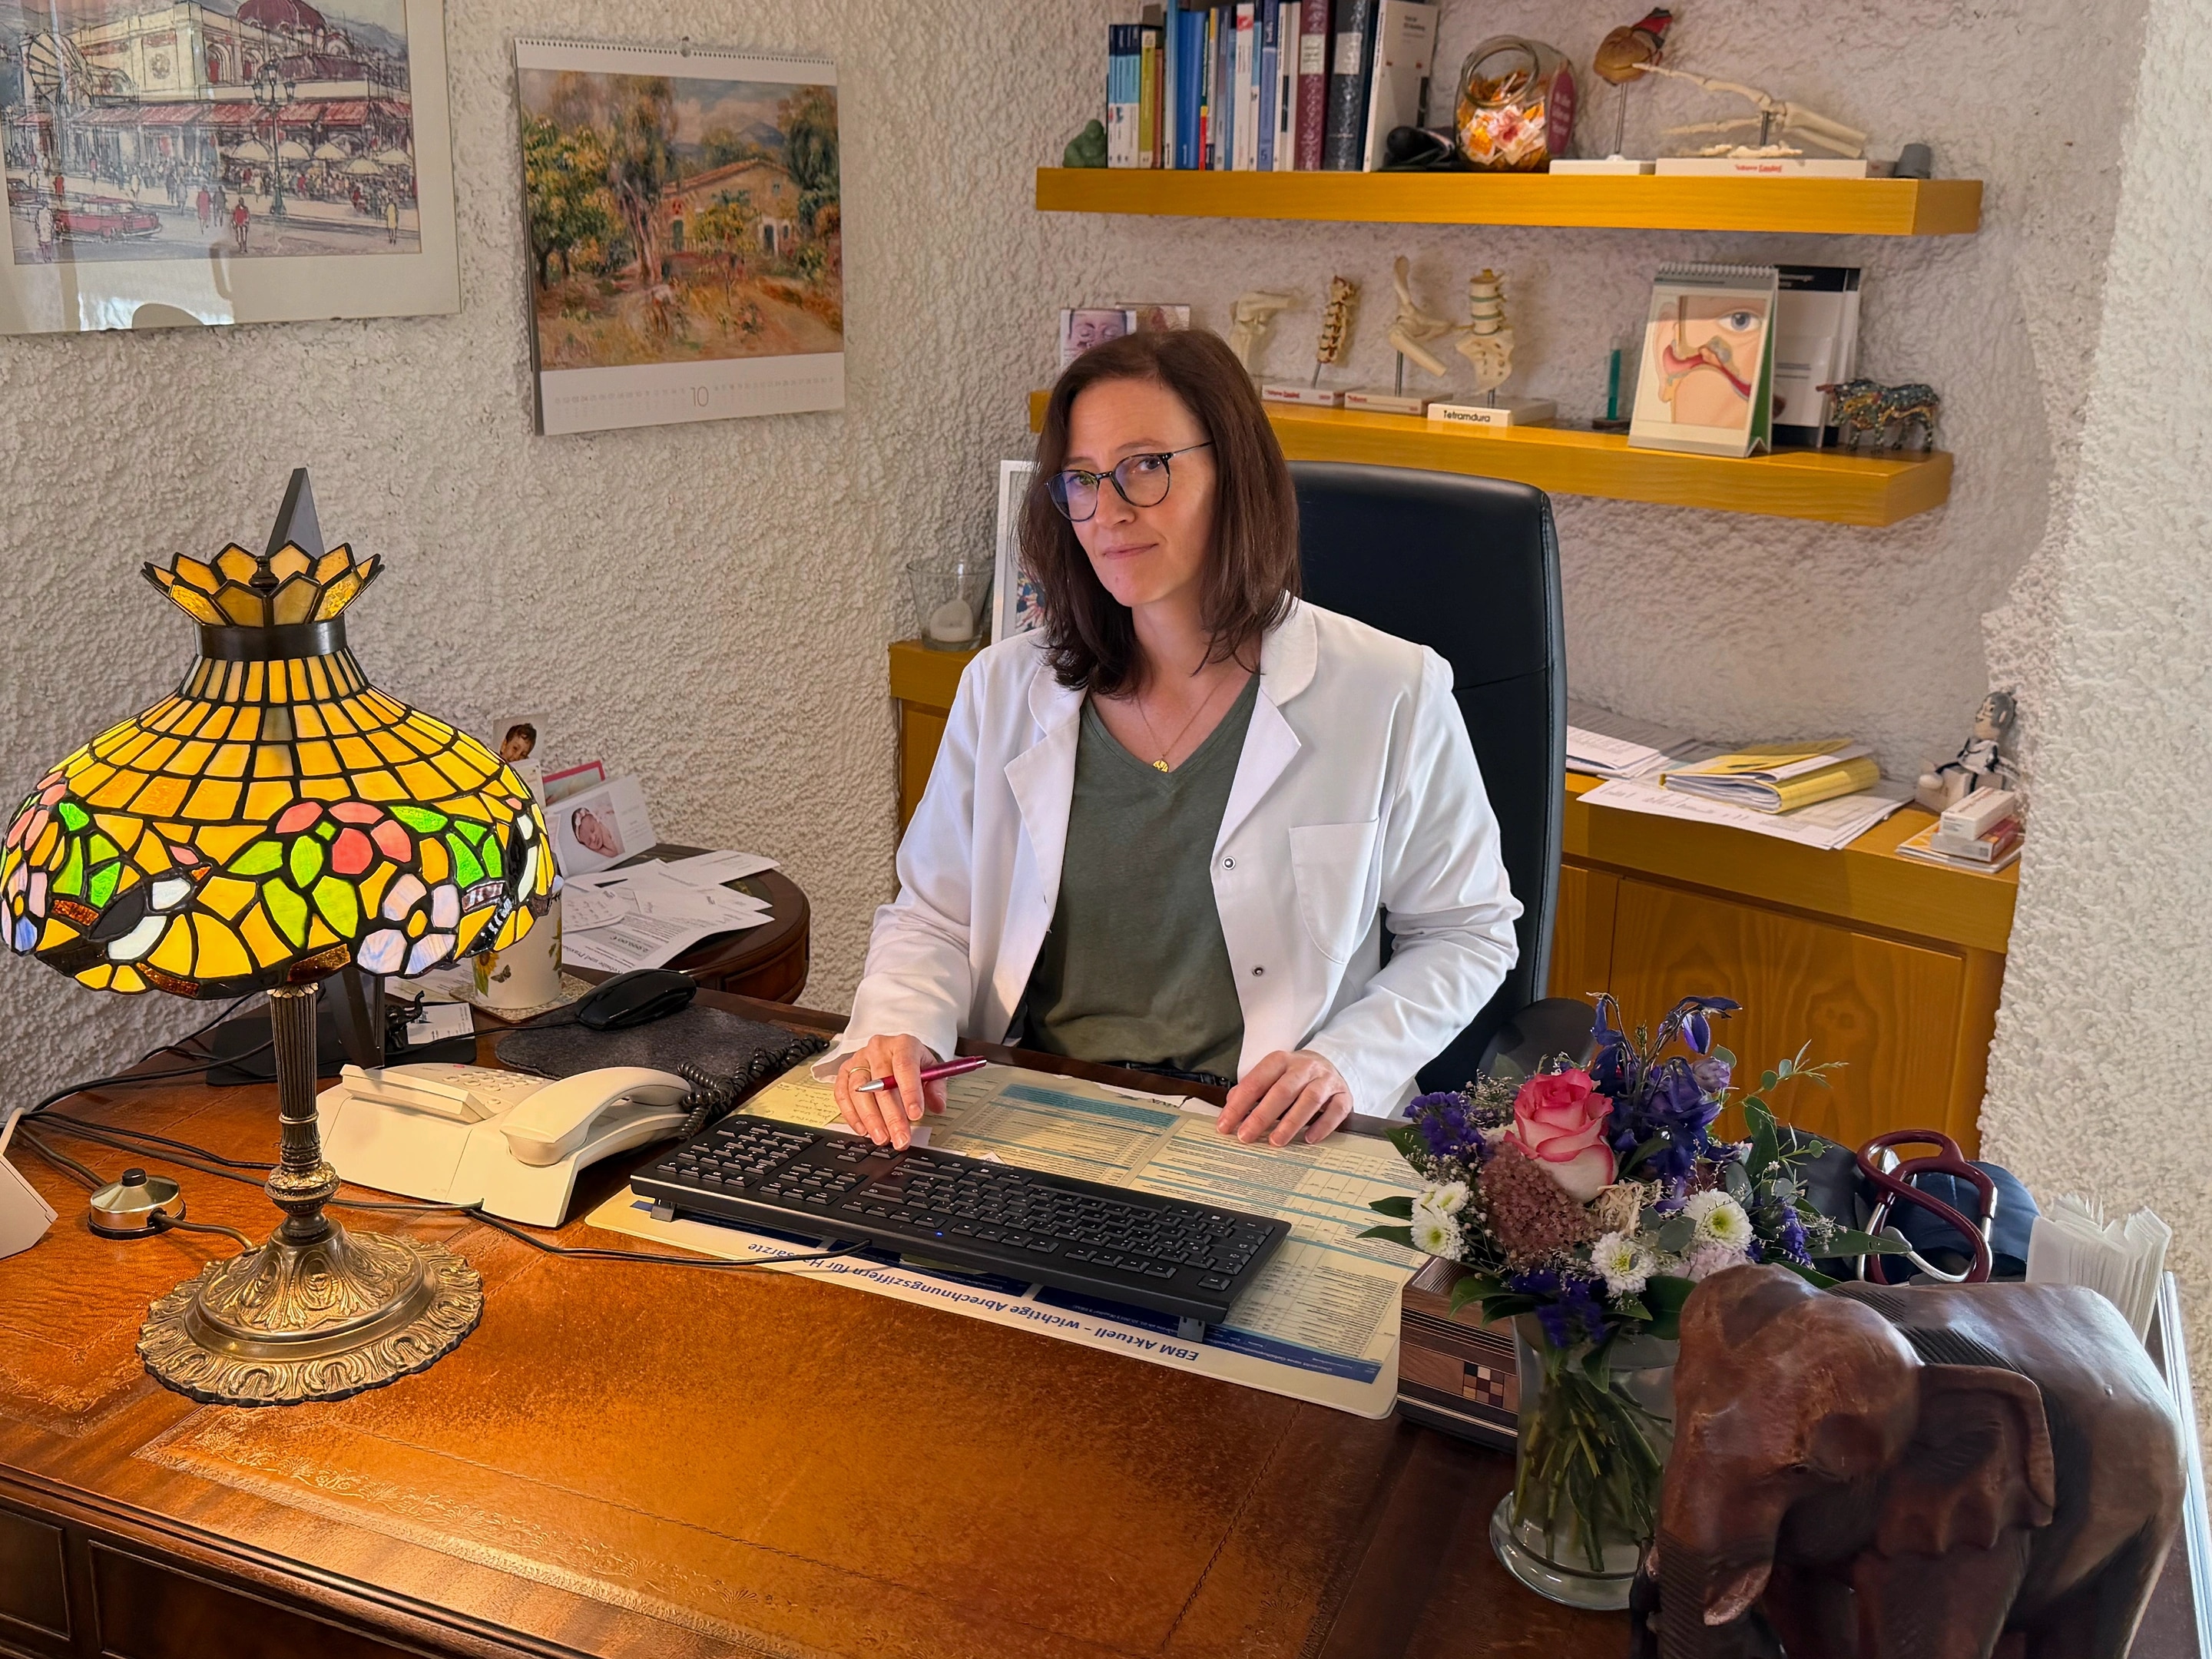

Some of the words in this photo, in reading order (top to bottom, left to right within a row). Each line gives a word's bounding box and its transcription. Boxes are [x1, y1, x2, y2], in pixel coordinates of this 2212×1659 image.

[690, 386, 709, 407] 10
[1443, 409, 1491, 422] Tetramdura
[747, 1243, 825, 1268] Hasärzte
[826, 1262, 849, 1273] für
[853, 1267, 1009, 1312] Abrechnungsziffern
[1010, 1306, 1080, 1329] wichtige
[1094, 1327, 1158, 1350] Aktuell
[1158, 1343, 1200, 1362] EBM
